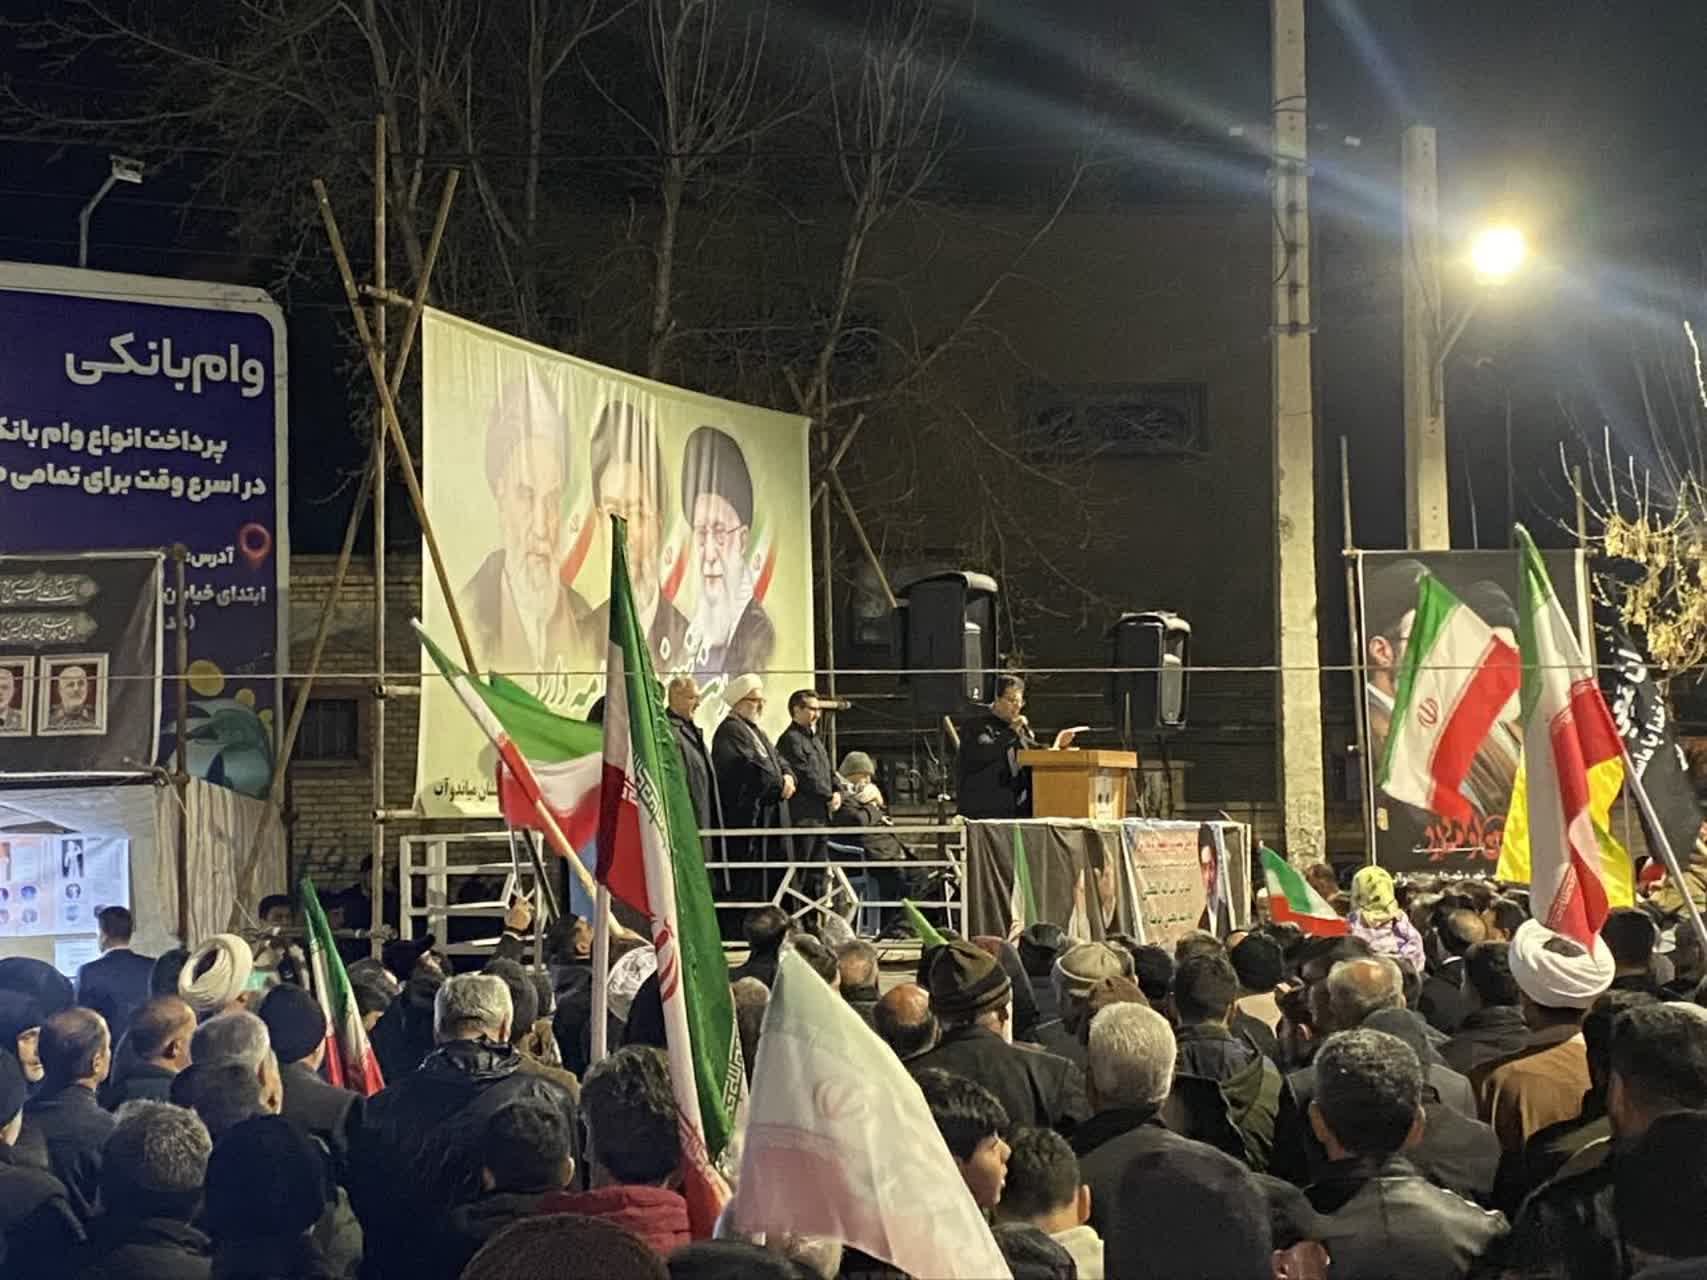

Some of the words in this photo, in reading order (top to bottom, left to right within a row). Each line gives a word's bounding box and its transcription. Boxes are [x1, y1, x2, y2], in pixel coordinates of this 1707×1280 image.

[0, 416, 39, 448] بانک
[41, 421, 85, 451] وام
[88, 424, 142, 456] انواع
[144, 428, 228, 464] پرداخت
[10, 462, 81, 491] تمامی
[83, 466, 132, 495] برای
[134, 468, 184, 498] وقت
[187, 473, 239, 502] اسرع
[241, 478, 266, 501] در
[162, 584, 215, 605] خیان
[216, 585, 267, 607] ابتدای
